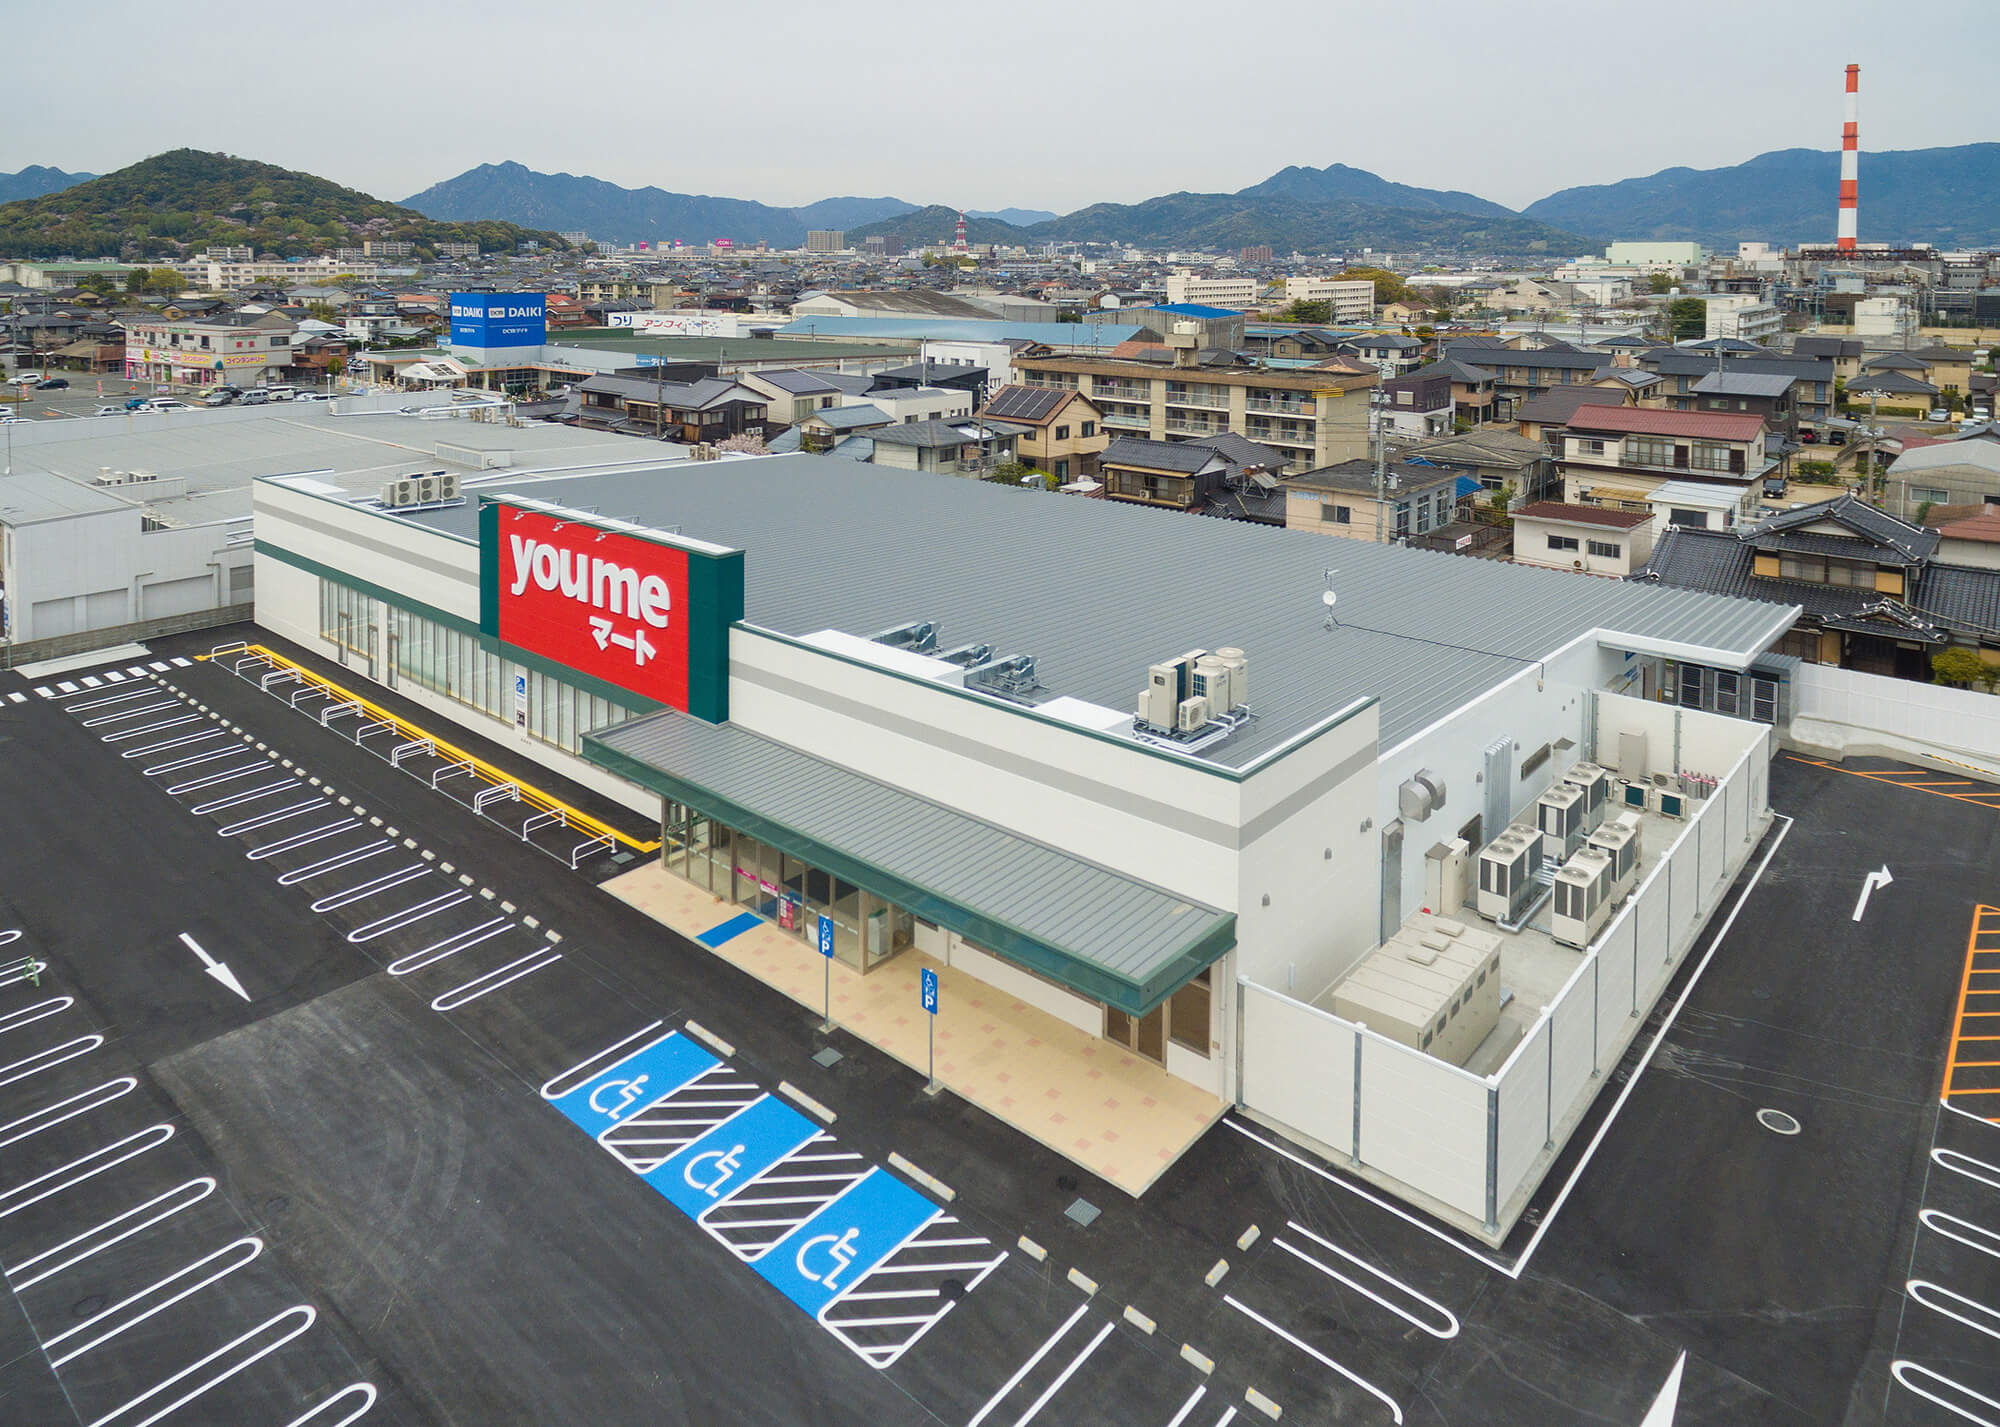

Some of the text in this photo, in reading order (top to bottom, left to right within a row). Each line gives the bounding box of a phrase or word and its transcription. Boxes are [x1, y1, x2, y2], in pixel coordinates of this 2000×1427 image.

[463, 306, 483, 318] DAIKI
[508, 307, 542, 318] DAIKI
[613, 315, 632, 327] つり
[509, 533, 671, 629] youme
[588, 615, 657, 667] マート
[822, 940, 830, 953] P
[925, 994, 934, 1008] P
